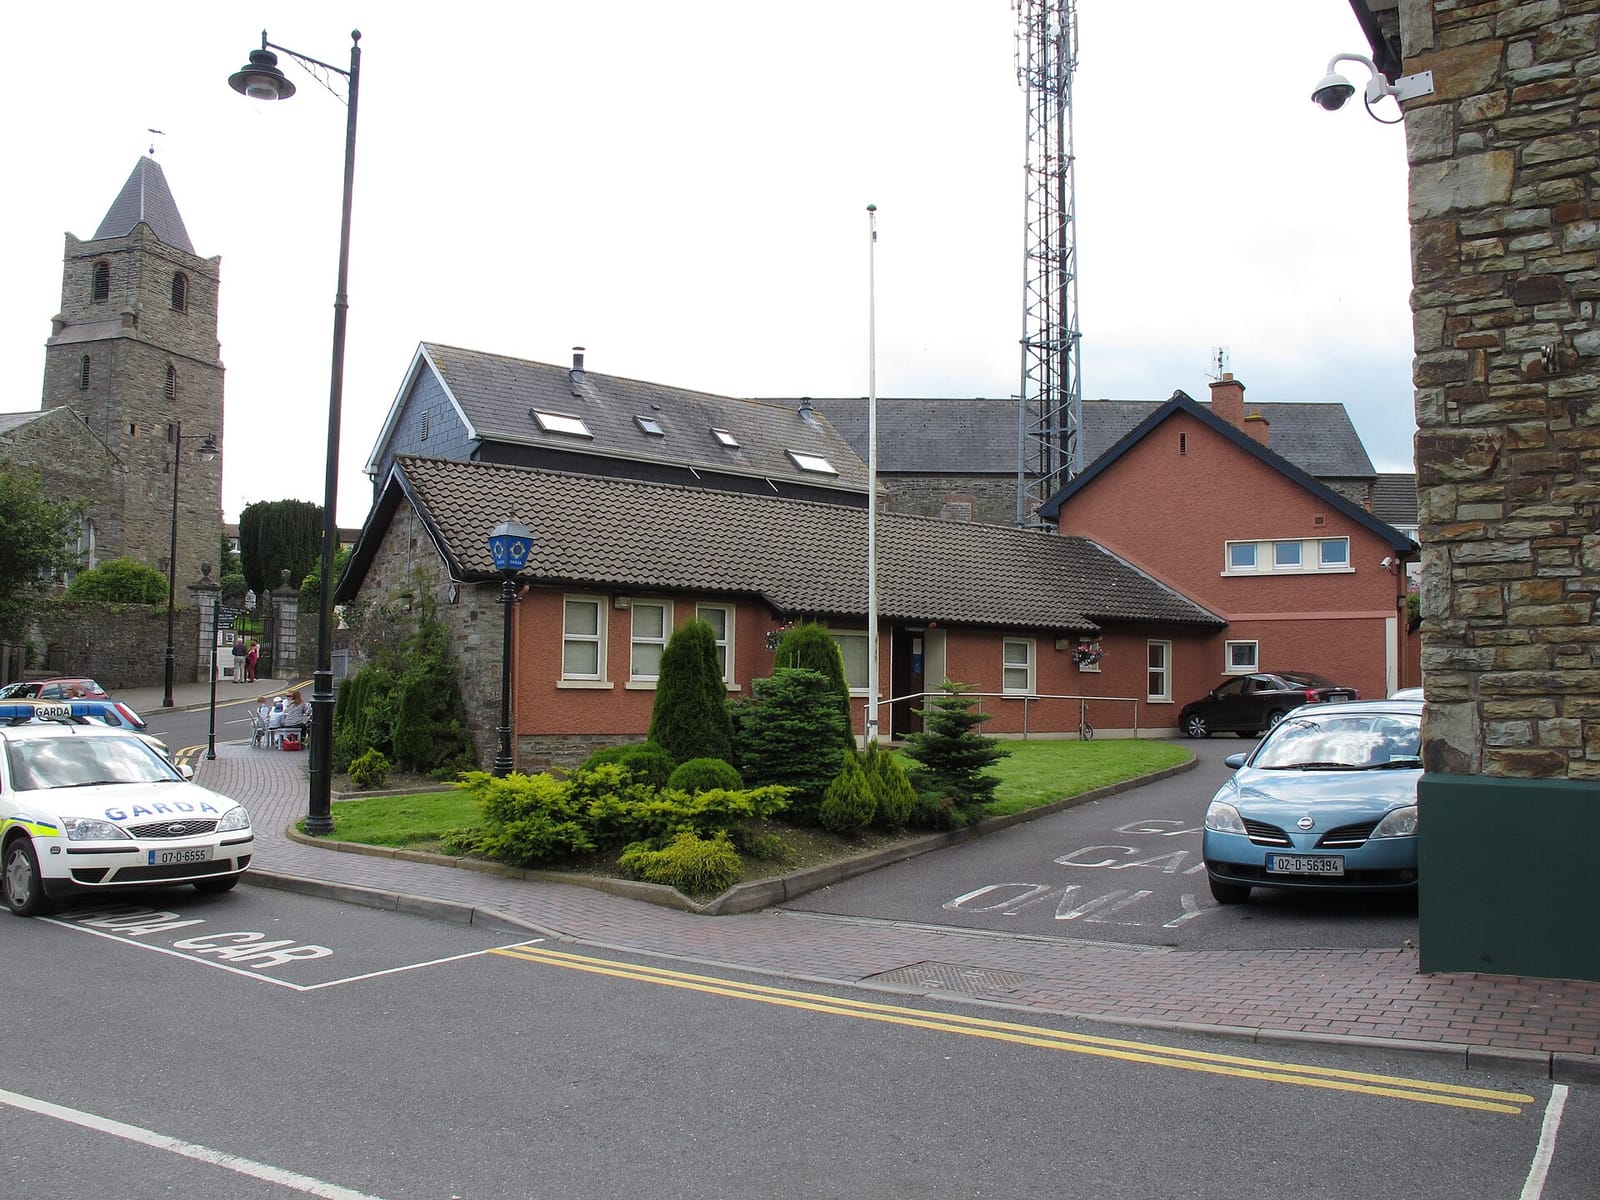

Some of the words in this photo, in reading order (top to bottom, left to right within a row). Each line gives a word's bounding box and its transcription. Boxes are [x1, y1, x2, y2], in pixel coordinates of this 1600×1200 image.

[35, 706, 70, 717] GARDA
[104, 801, 219, 821] GARDA
[162, 850, 206, 863] 07-D-6555
[1053, 845, 1205, 874] CA
[1278, 858, 1338, 871] 02-D-56394
[173, 931, 334, 969] CAR
